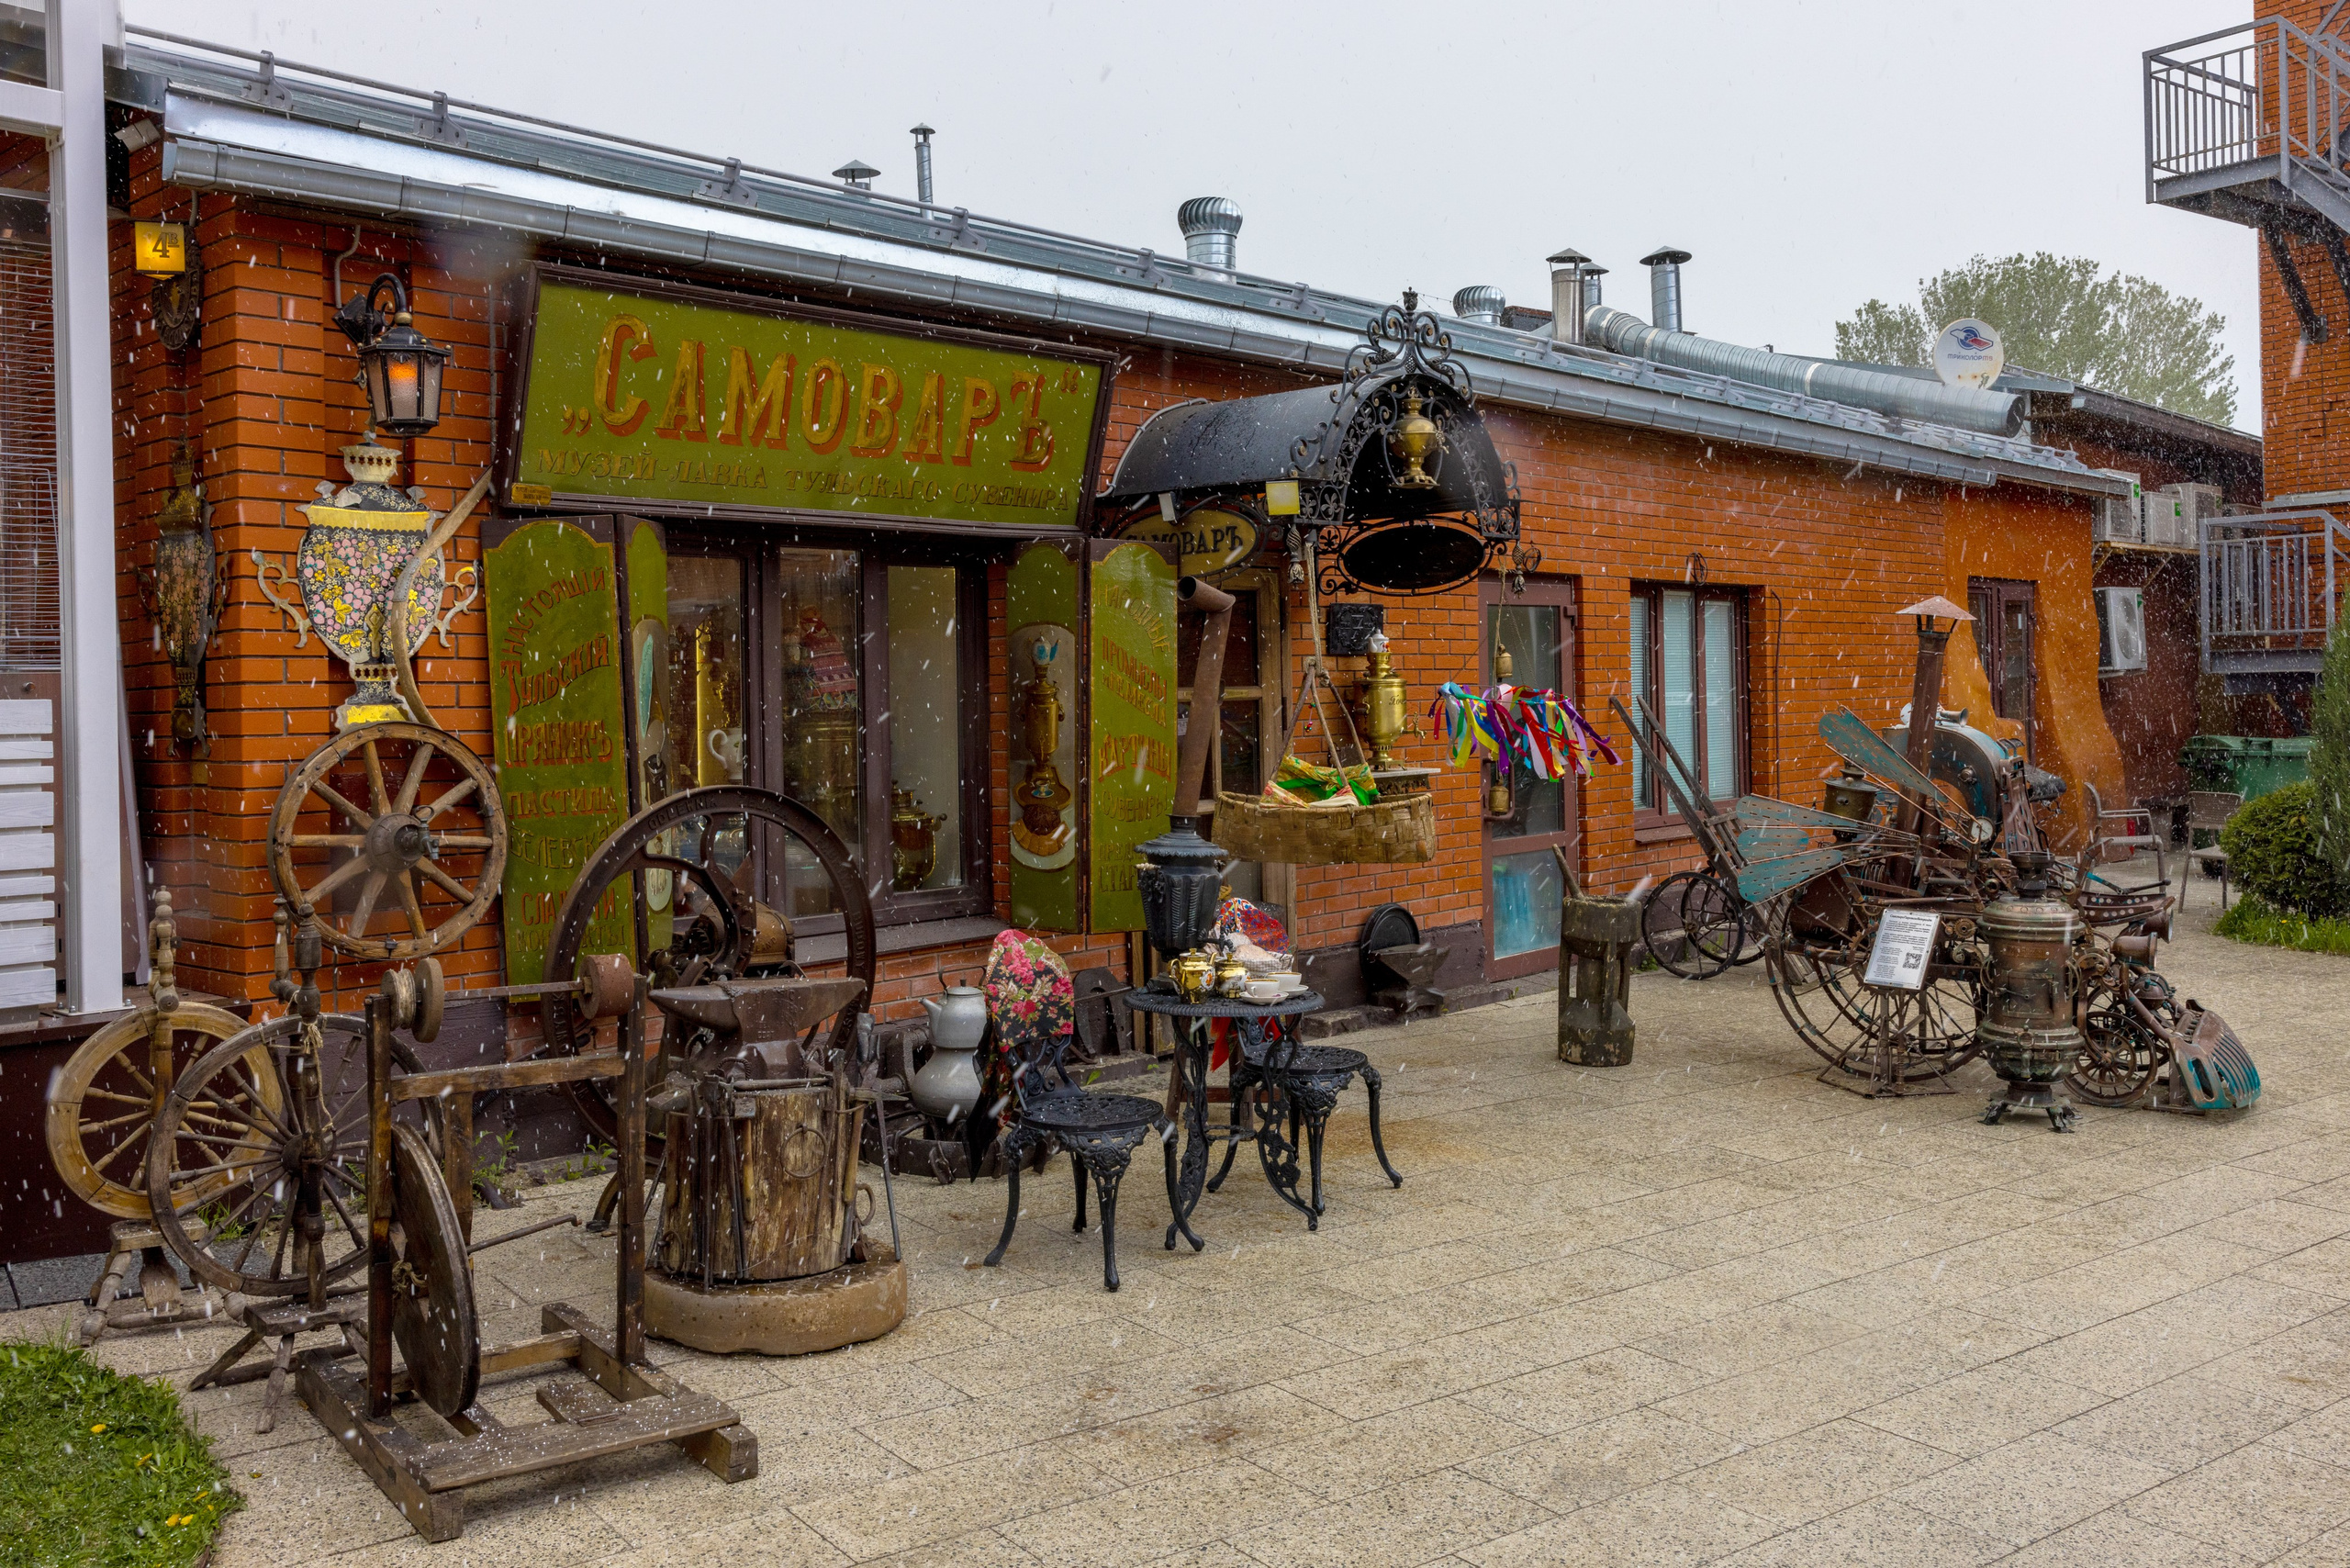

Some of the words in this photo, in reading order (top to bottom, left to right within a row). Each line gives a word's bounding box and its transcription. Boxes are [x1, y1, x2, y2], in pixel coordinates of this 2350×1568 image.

[783, 469, 941, 502] ТУЛЬСКАГО
[951, 482, 1069, 510] СУВЕНИРА
[1102, 635, 1168, 704] ПРОМЫСЛЫ
[505, 720, 614, 767] ПРЯНИКЪ
[507, 786, 618, 820] ПАСТИЛА
[514, 925, 625, 952] КОНКТЫ
